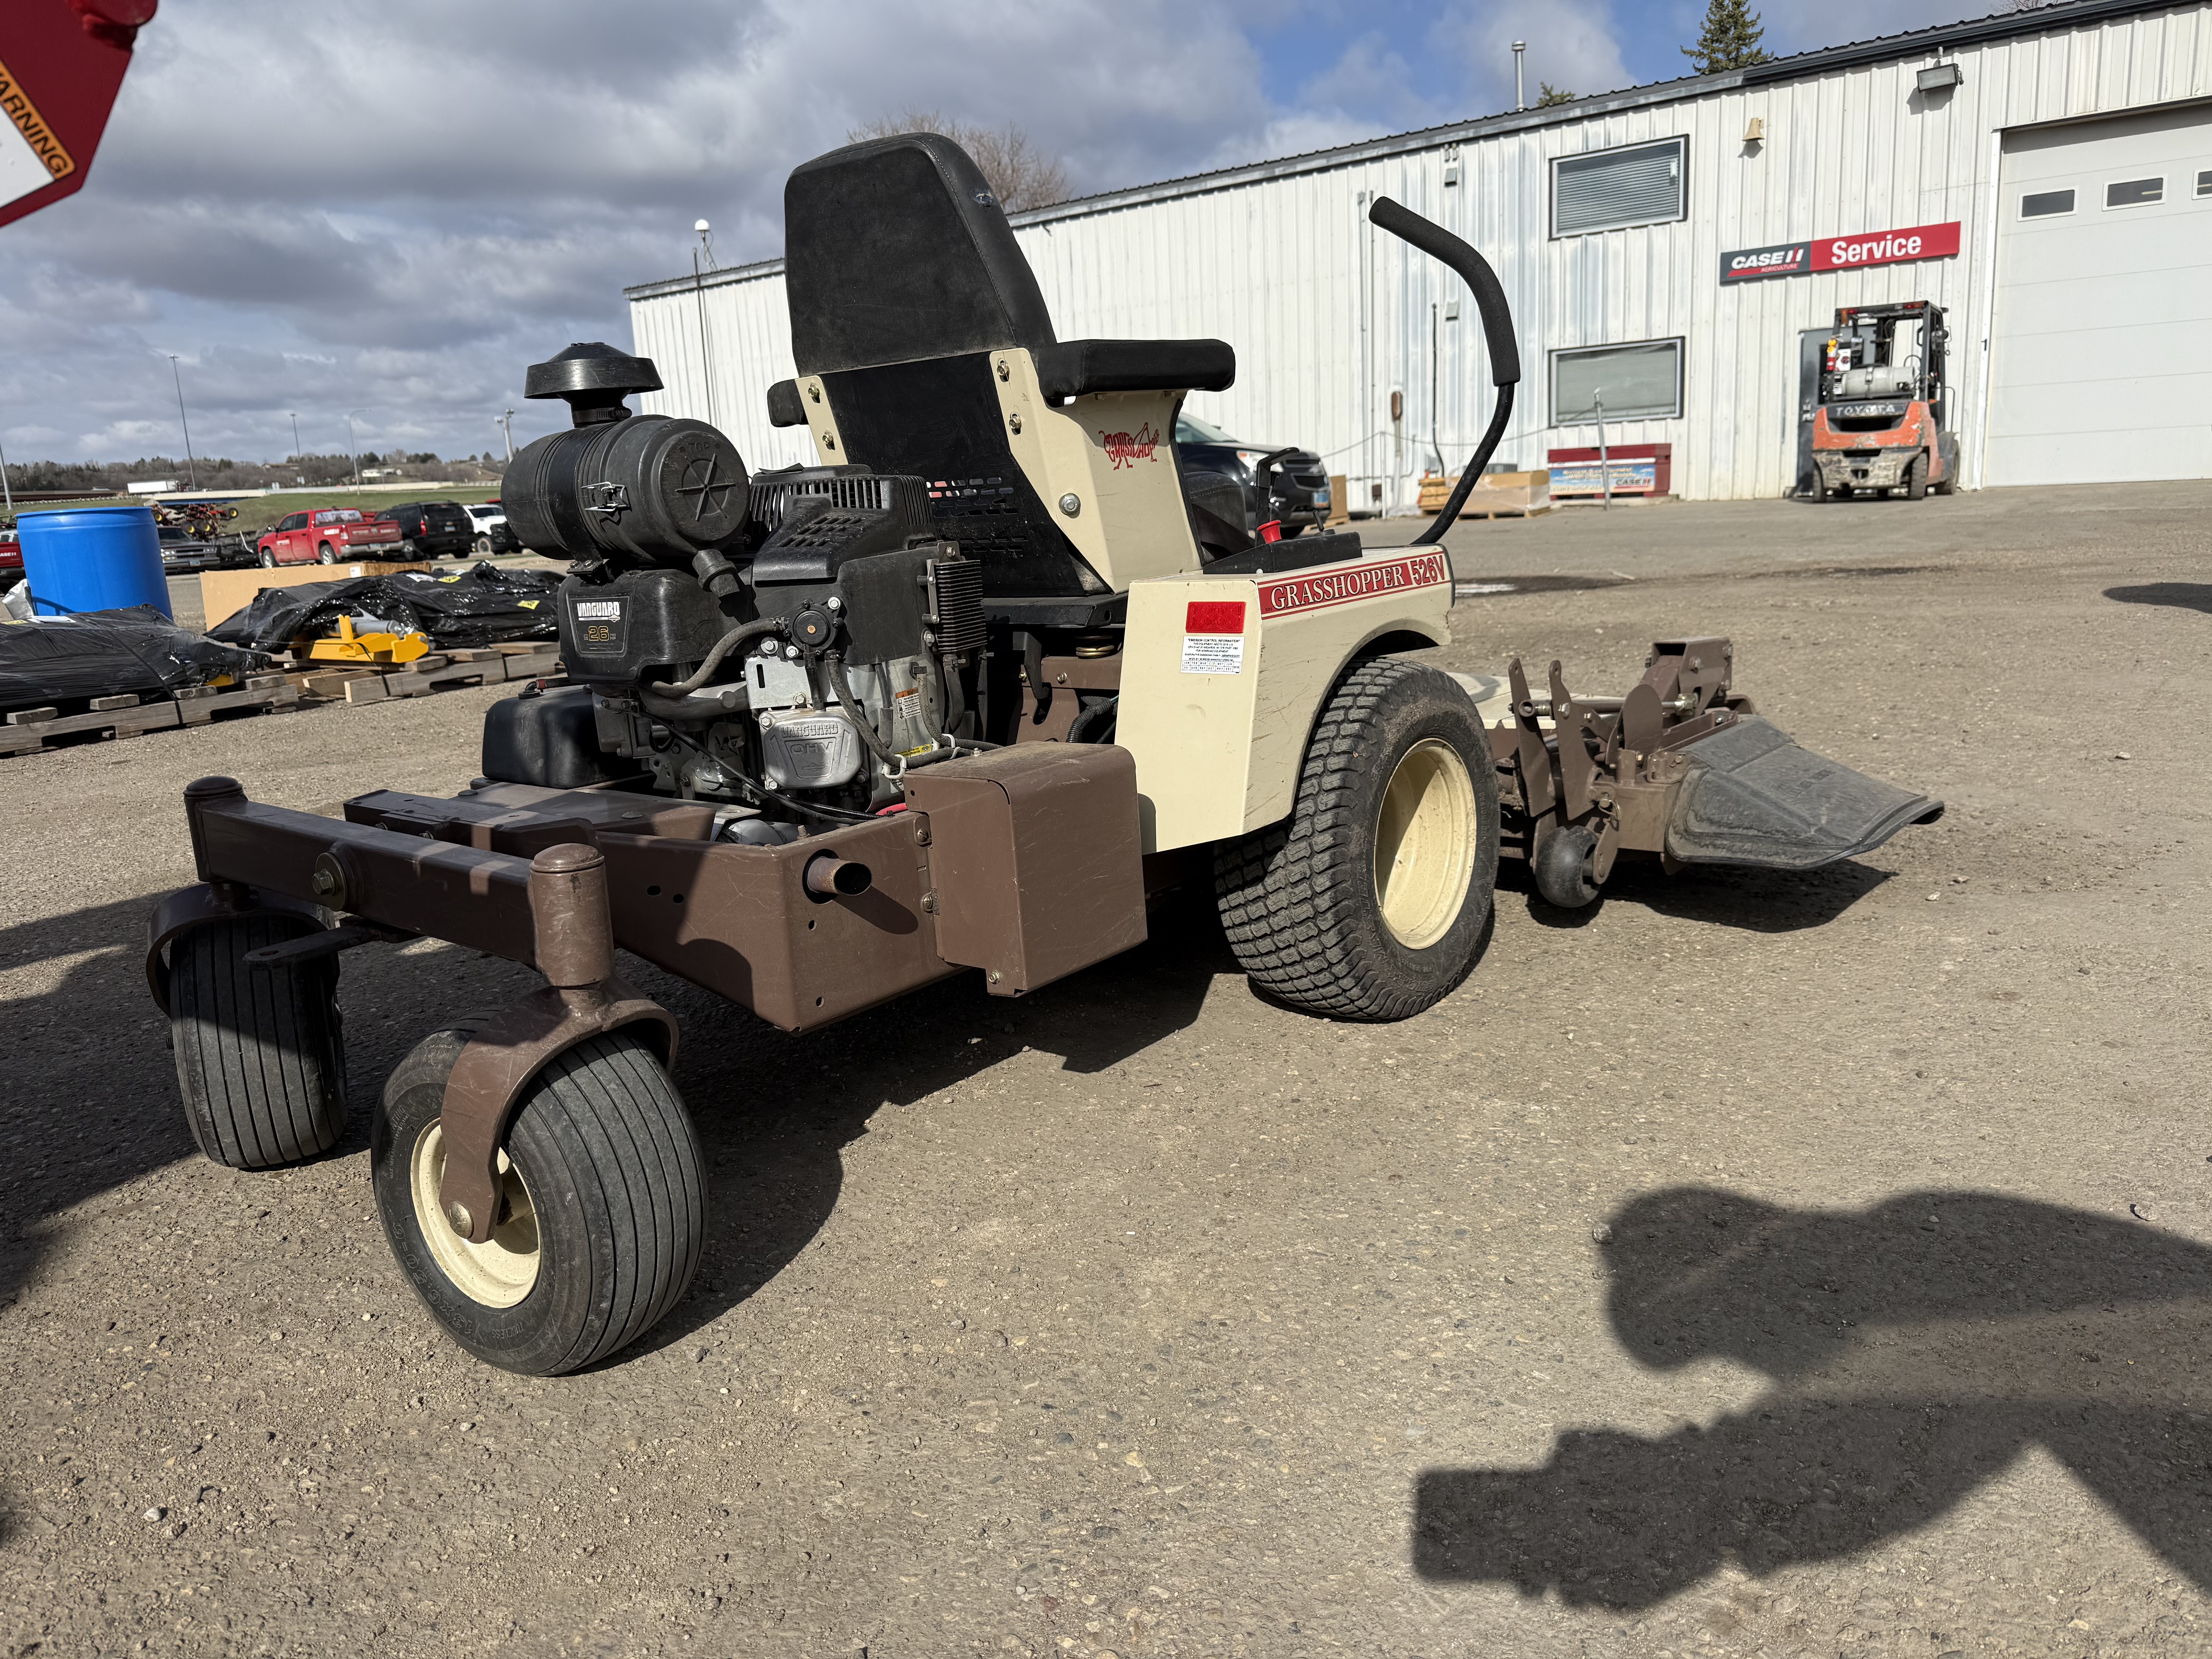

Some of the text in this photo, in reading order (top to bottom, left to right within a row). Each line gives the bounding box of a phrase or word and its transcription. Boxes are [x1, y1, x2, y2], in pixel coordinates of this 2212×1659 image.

[0, 72, 67, 174] ARNING
[1831, 234, 1922, 264] Service
[1731, 251, 1785, 270] CASE
[1836, 404, 1895, 416] TOYOTA
[1271, 555, 1445, 610] GRASSHOPPER 526V
[577, 601, 620, 617] VANGUARD
[588, 625, 610, 641] 26
[780, 722, 838, 738] VANGUARD
[790, 741, 833, 755] OHV
